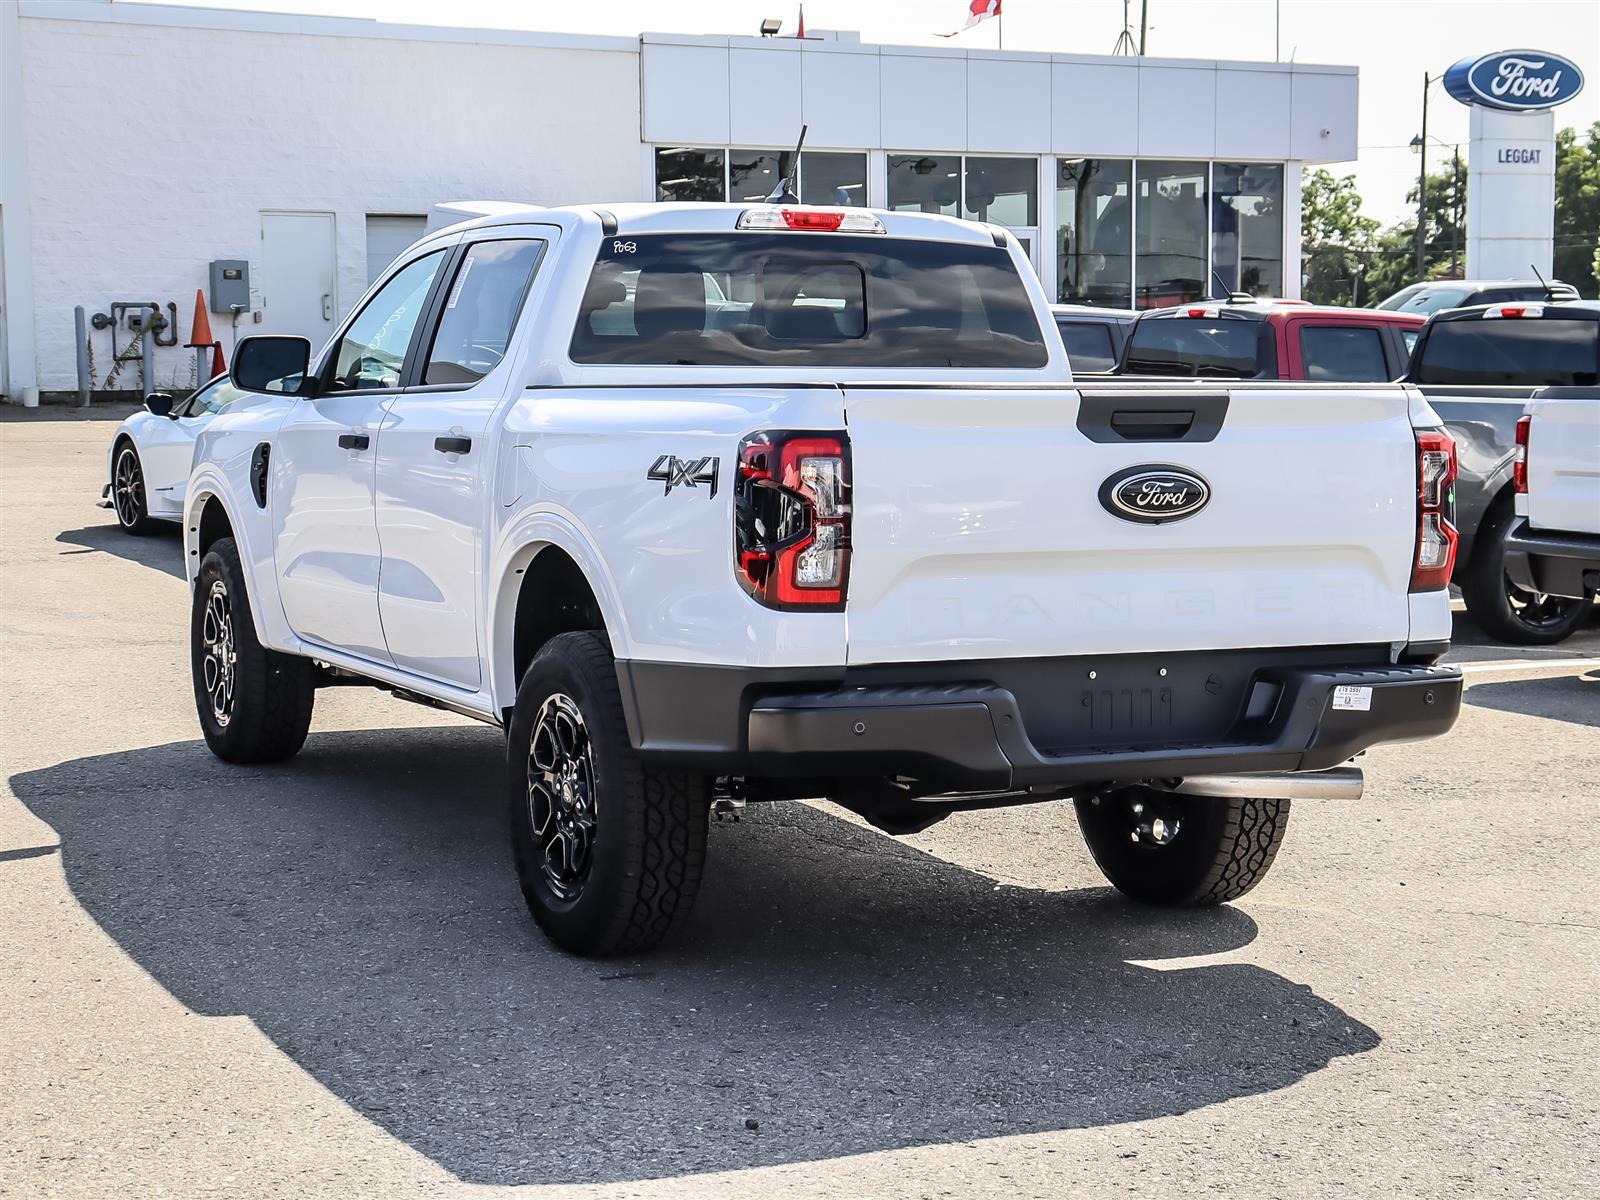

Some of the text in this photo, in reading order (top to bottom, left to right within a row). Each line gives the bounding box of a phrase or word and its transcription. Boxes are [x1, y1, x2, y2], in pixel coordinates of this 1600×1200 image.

[1491, 58, 1562, 98] Ford
[1498, 149, 1541, 163] LEGGAT
[1136, 481, 1188, 506] Ford
[906, 583, 1380, 636] RANGER
